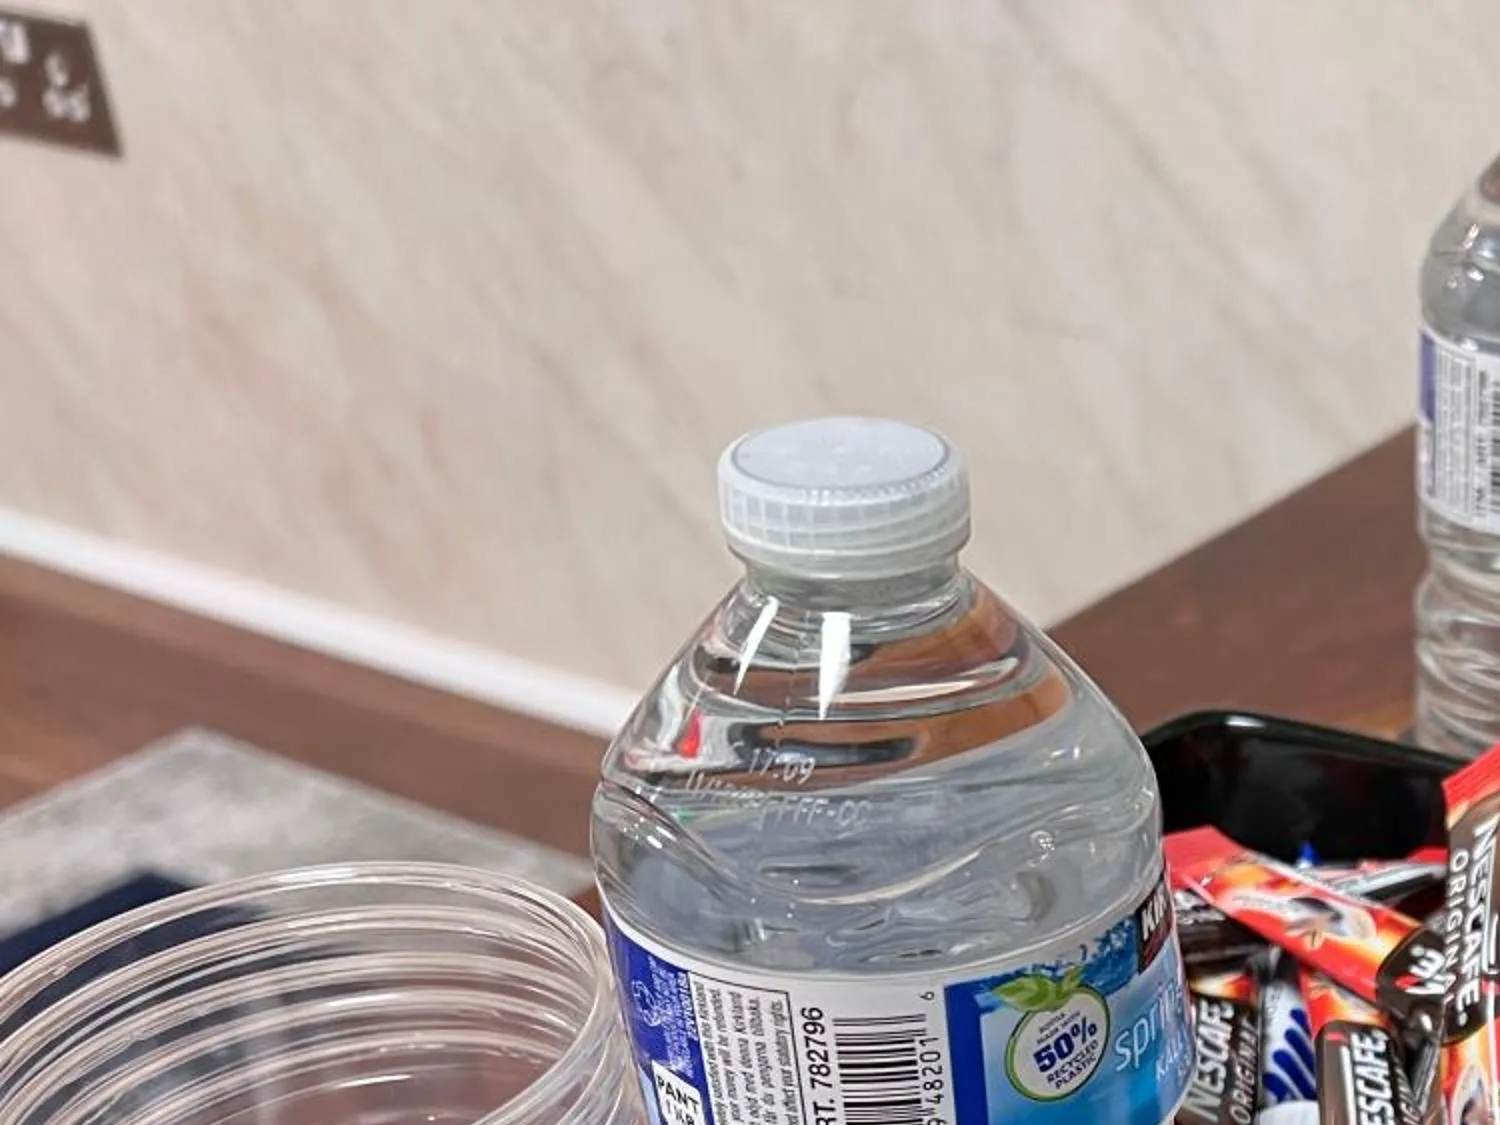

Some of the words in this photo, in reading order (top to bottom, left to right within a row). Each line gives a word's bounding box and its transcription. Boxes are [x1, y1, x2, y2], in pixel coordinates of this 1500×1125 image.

[1443, 849, 1469, 1003] ORIGINAL
[799, 1008, 832, 1087] 782796
[919, 1036, 944, 1105] 48201
[1033, 1015, 1098, 1073] 50%
[656, 1074, 700, 1114] PANT
